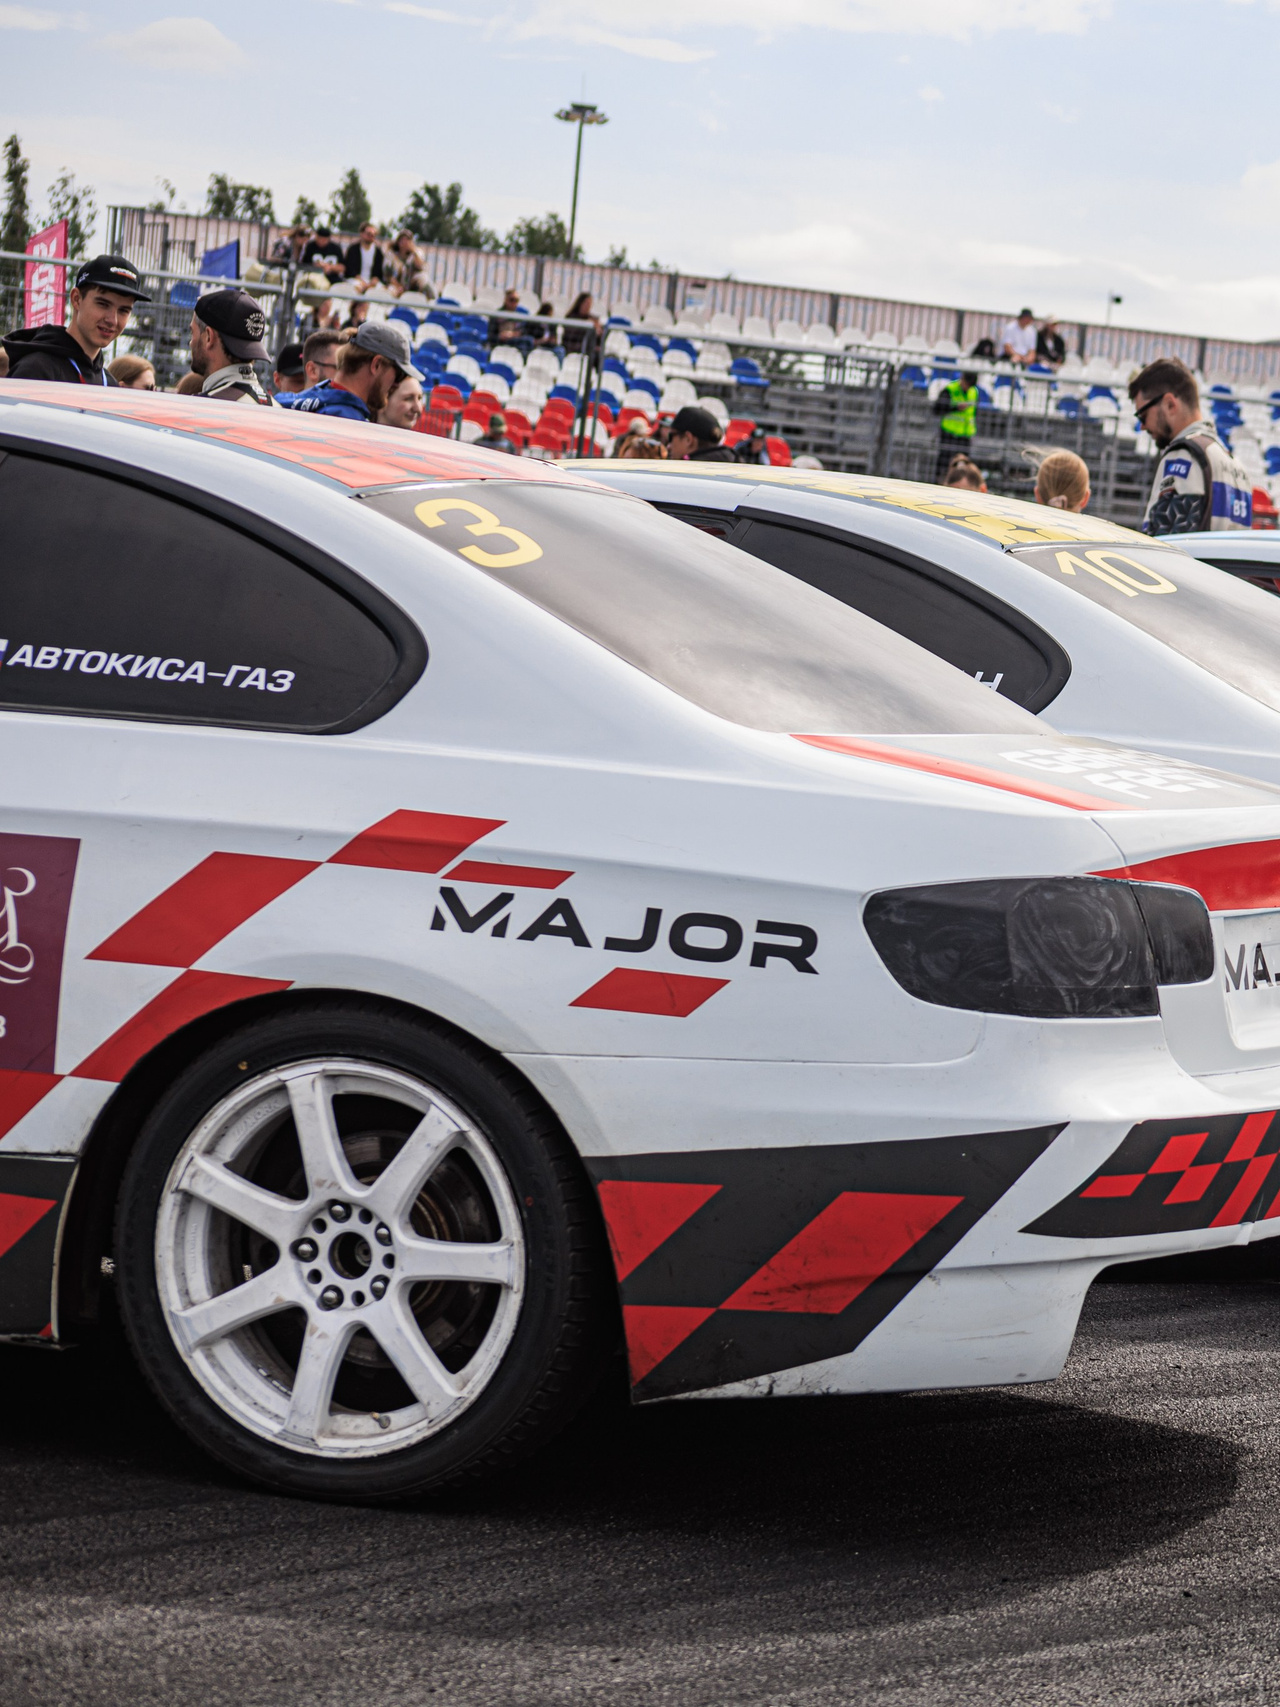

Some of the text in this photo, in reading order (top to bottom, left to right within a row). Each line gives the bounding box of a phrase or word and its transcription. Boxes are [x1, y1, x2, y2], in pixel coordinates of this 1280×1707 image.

[414, 498, 544, 568] 3
[1054, 550, 1178, 597] 10
[6, 644, 296, 692] АВТОКИСА-ГАЗ
[429, 886, 820, 975] MAJOR
